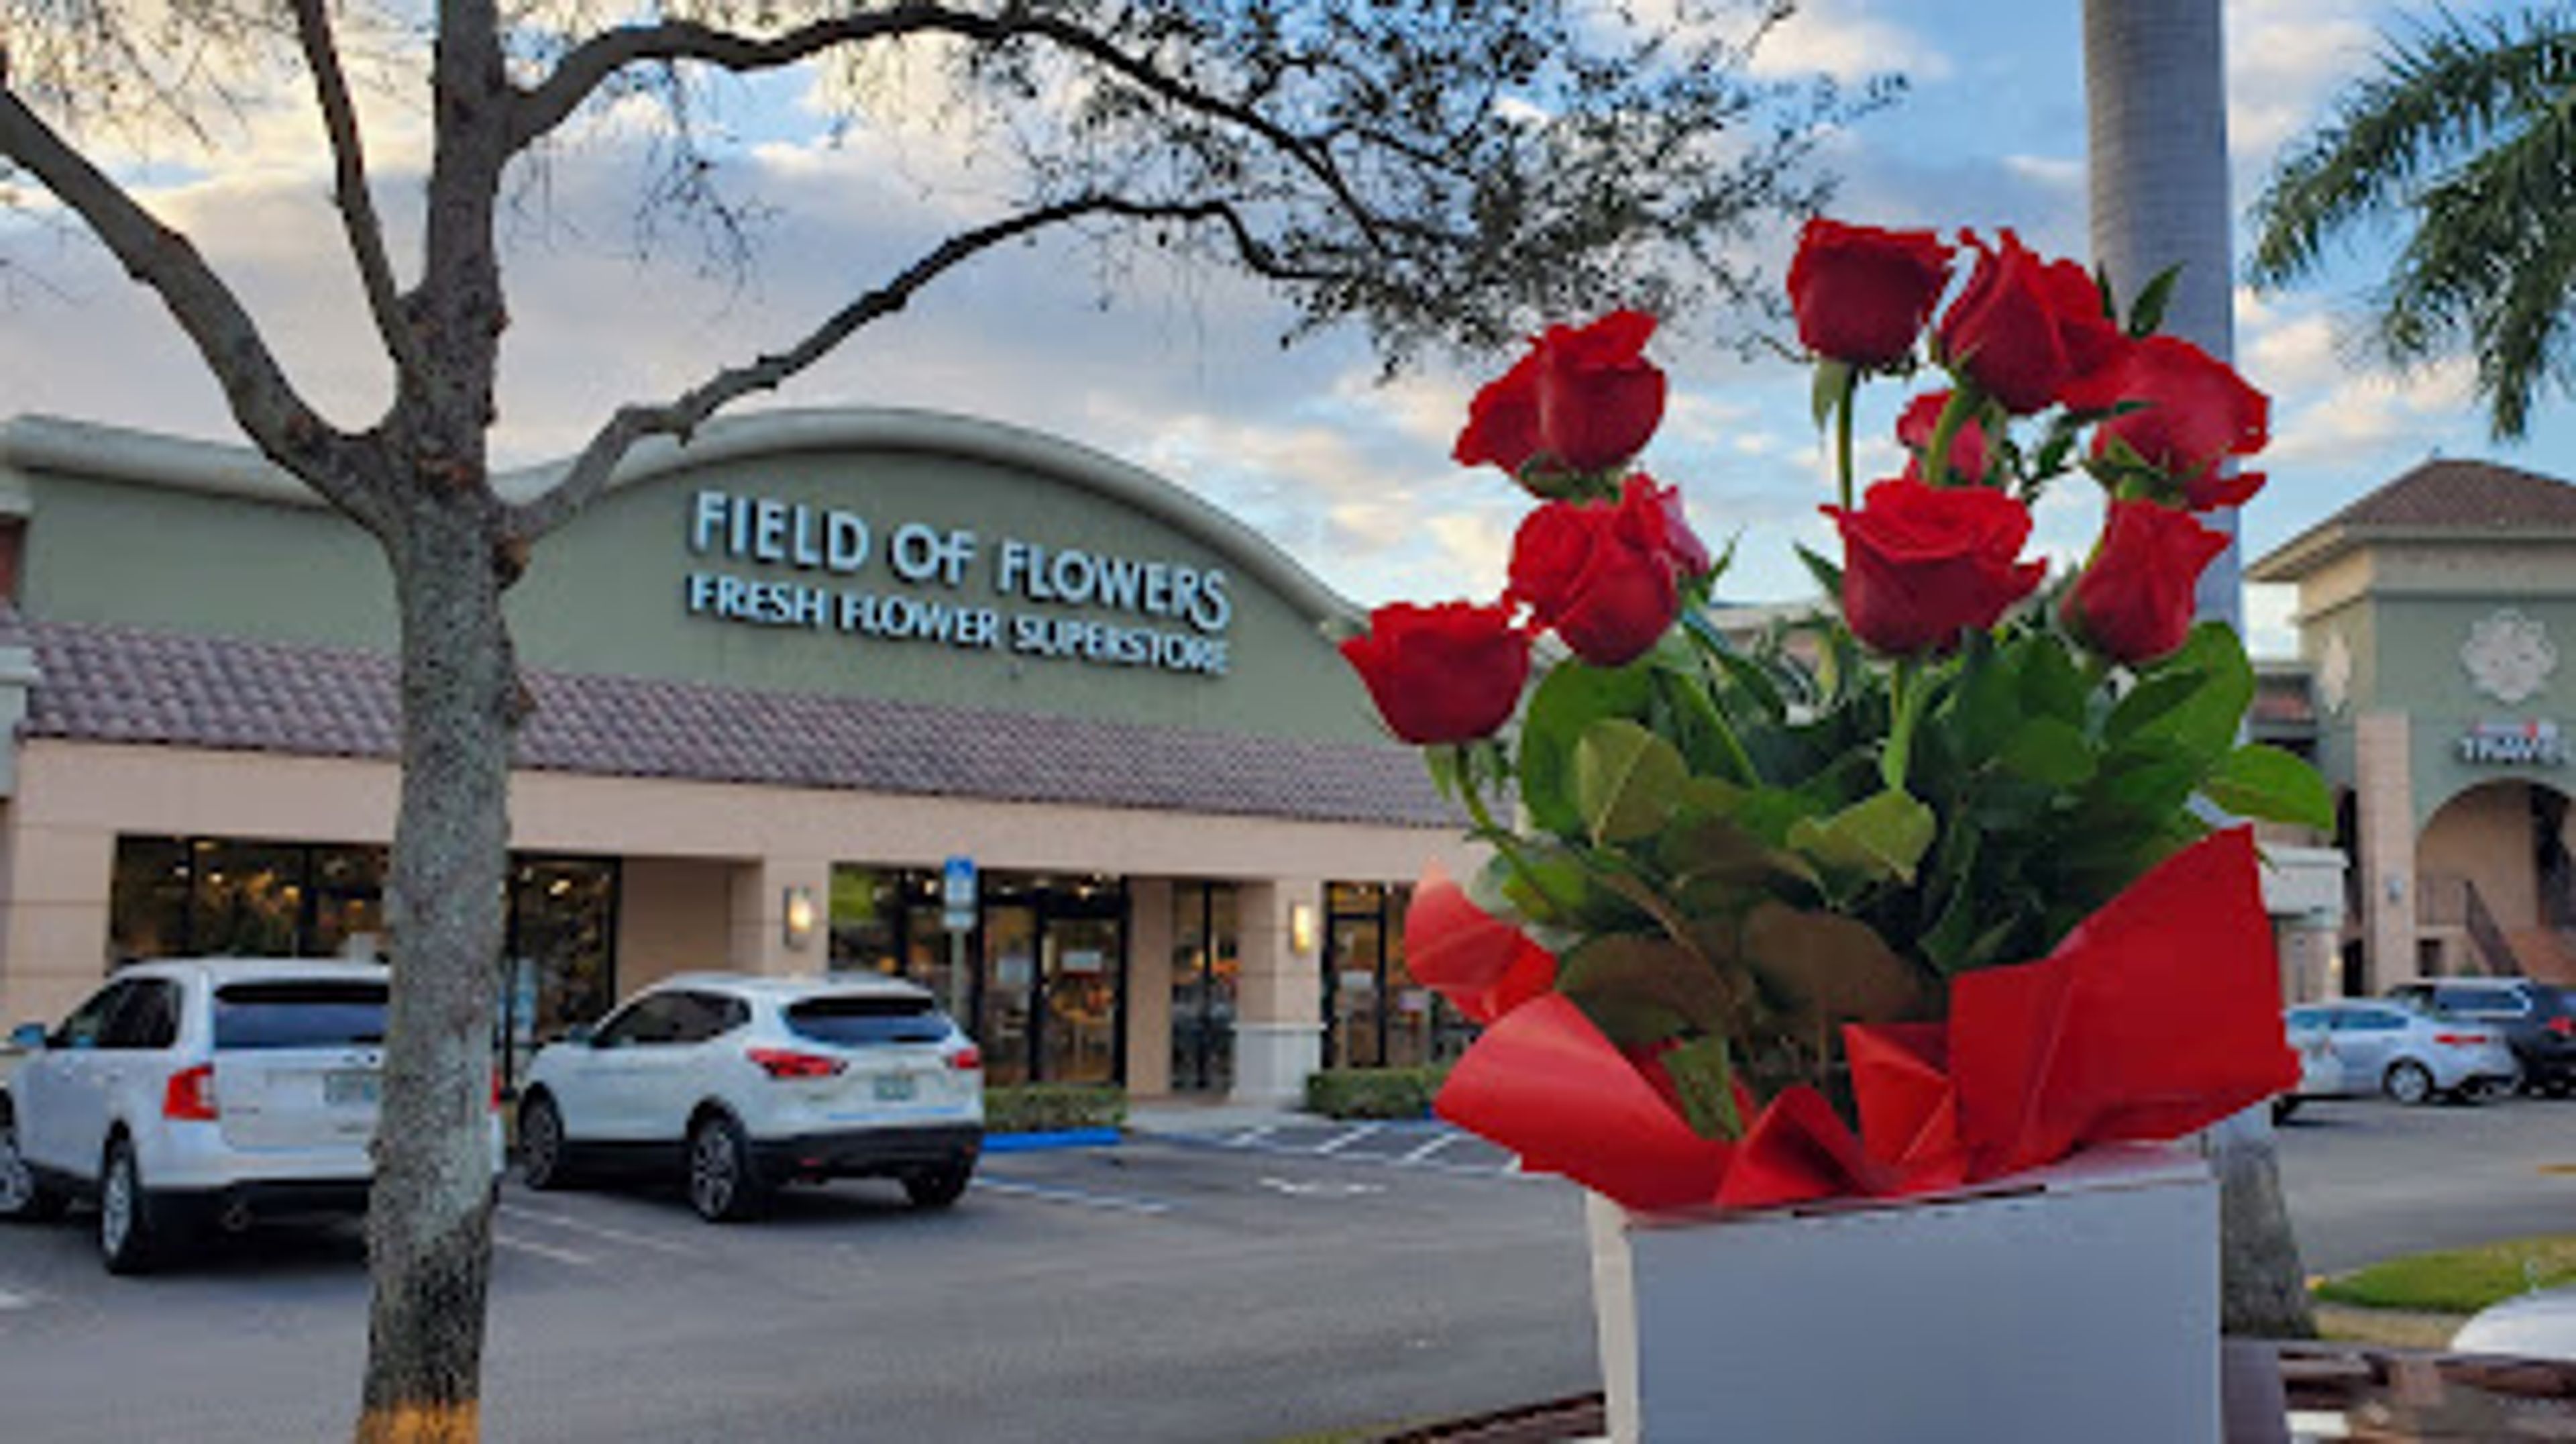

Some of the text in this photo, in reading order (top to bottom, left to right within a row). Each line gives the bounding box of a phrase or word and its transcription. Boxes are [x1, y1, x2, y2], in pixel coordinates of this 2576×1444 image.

[693, 490, 1231, 631] FIELD OF FLOWERS
[690, 573, 1230, 674] FRESH FLOWER SUPERSTORE
